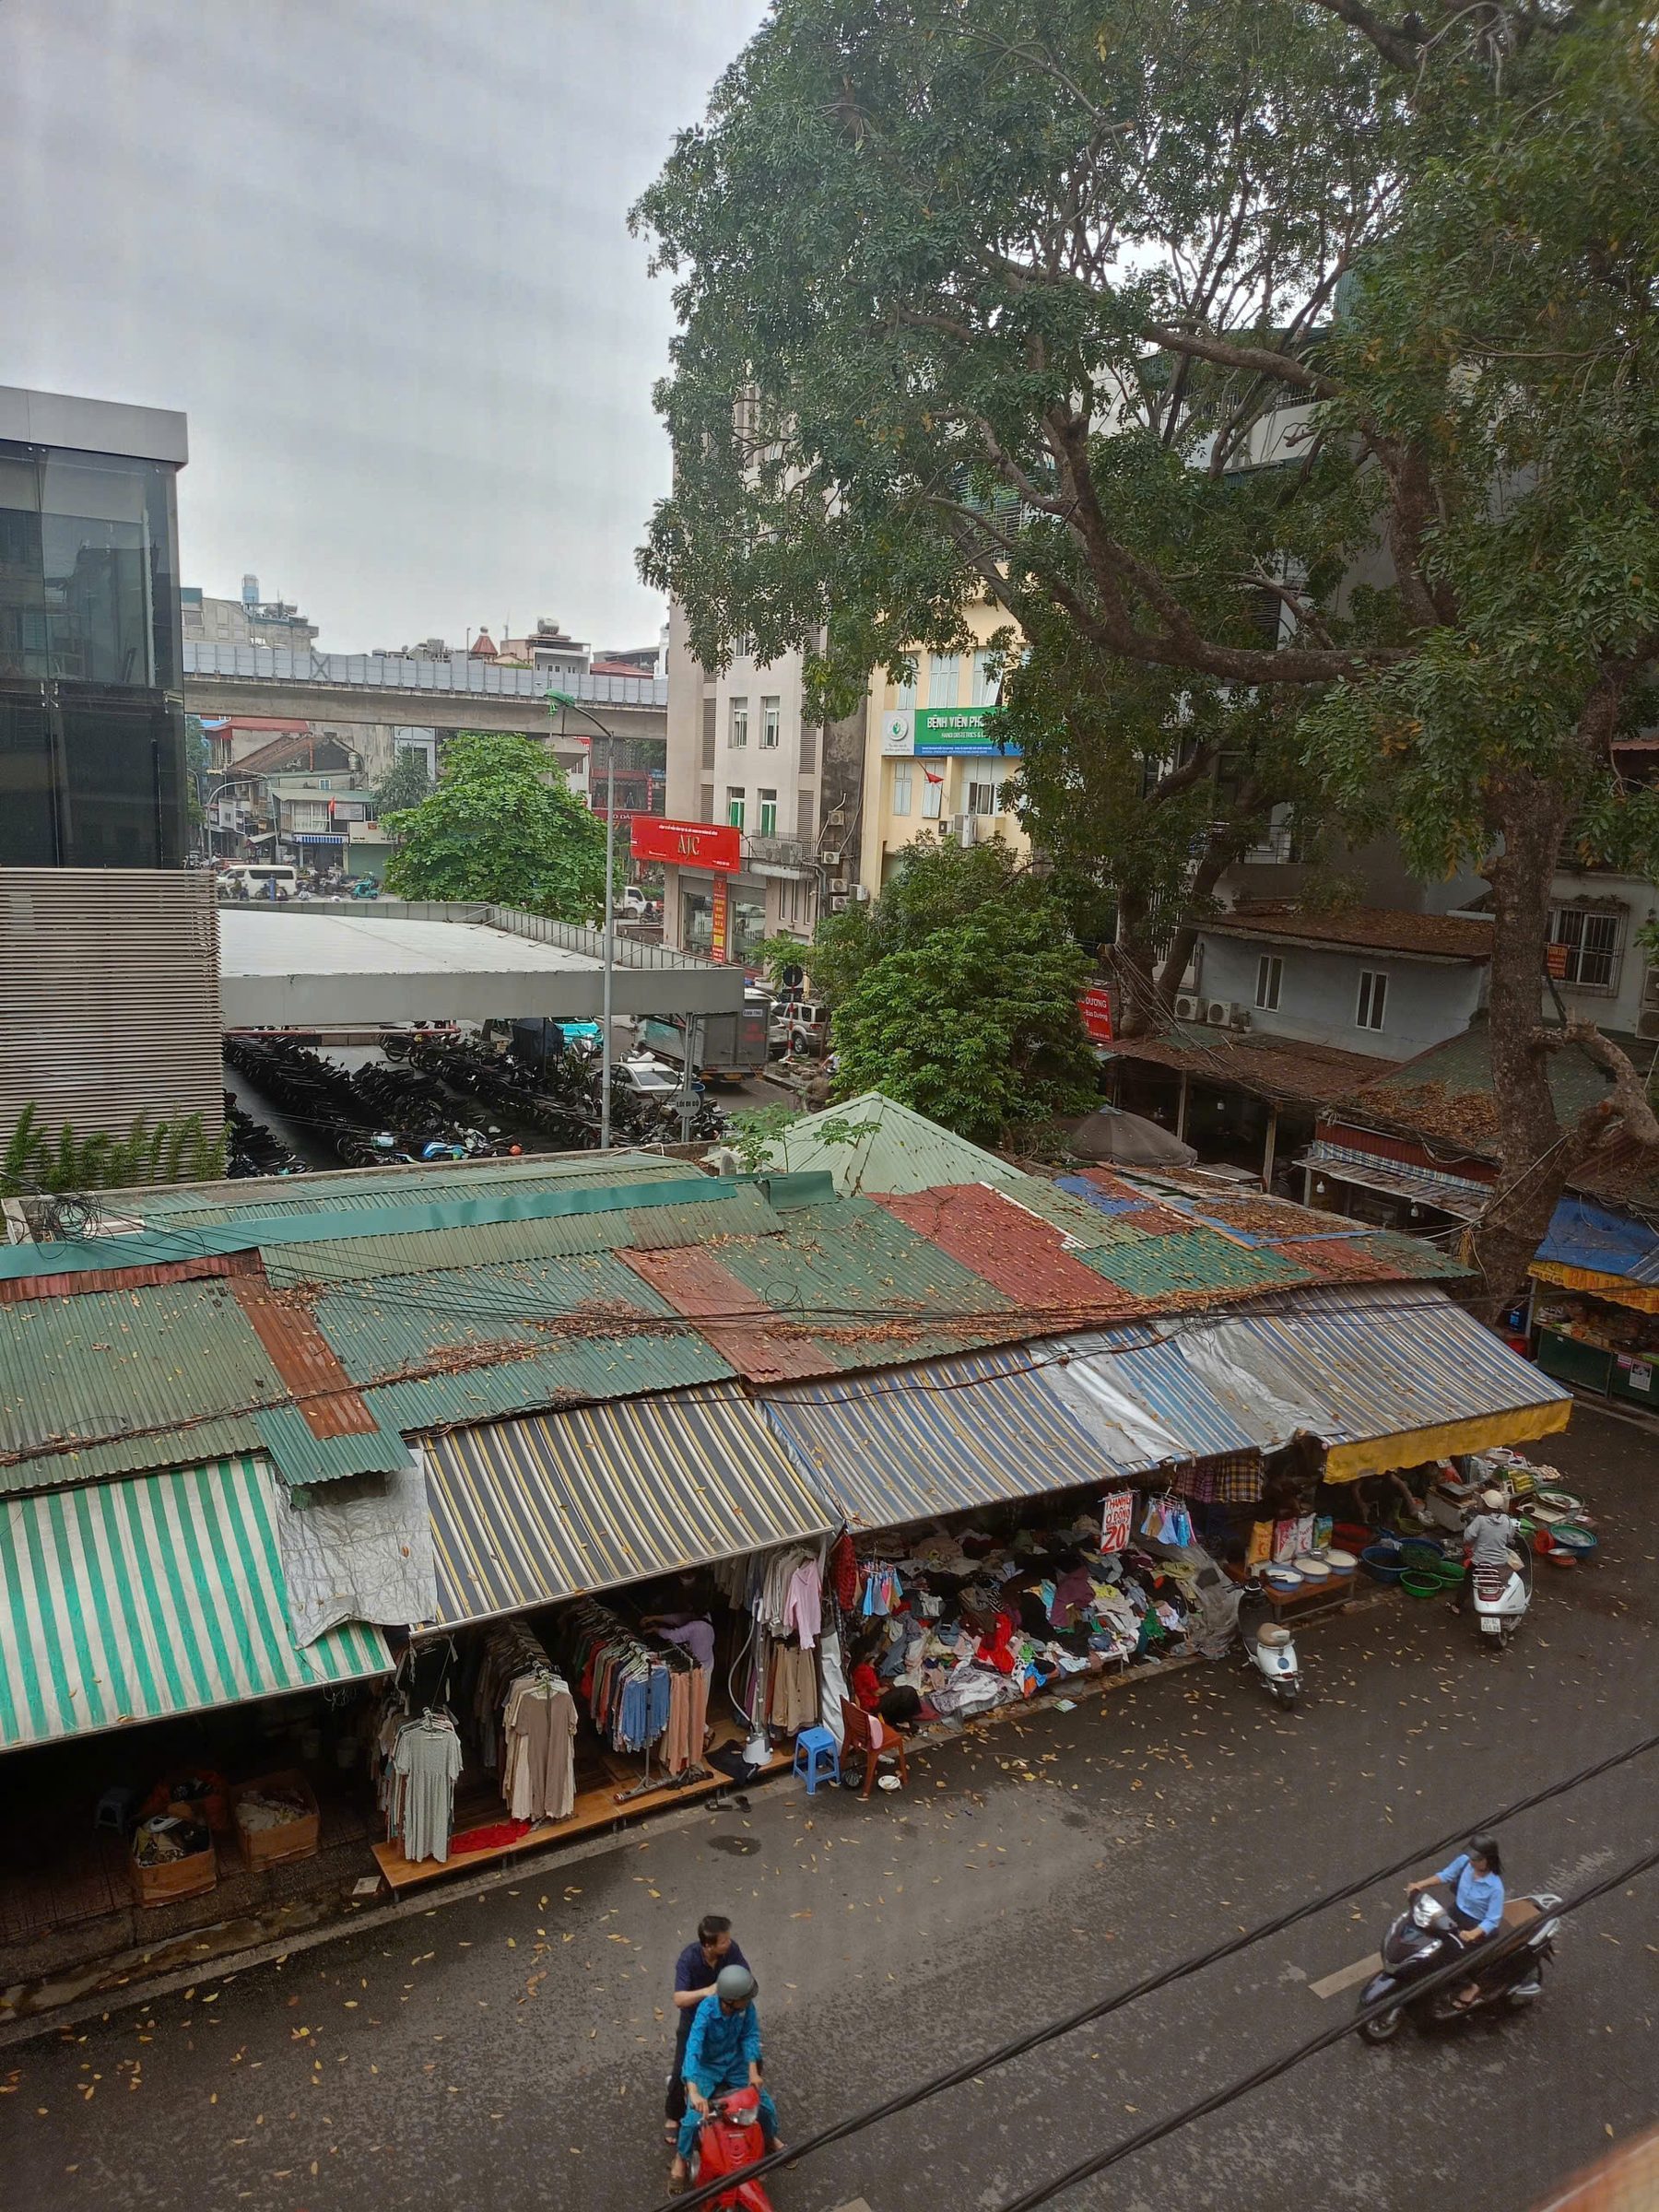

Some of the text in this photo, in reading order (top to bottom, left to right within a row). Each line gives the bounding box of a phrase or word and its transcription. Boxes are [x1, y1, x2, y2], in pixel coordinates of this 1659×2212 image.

[927, 713, 947, 730] BỆNH
[949, 713, 968, 729] VIỆN
[677, 834, 700, 857] AJC
